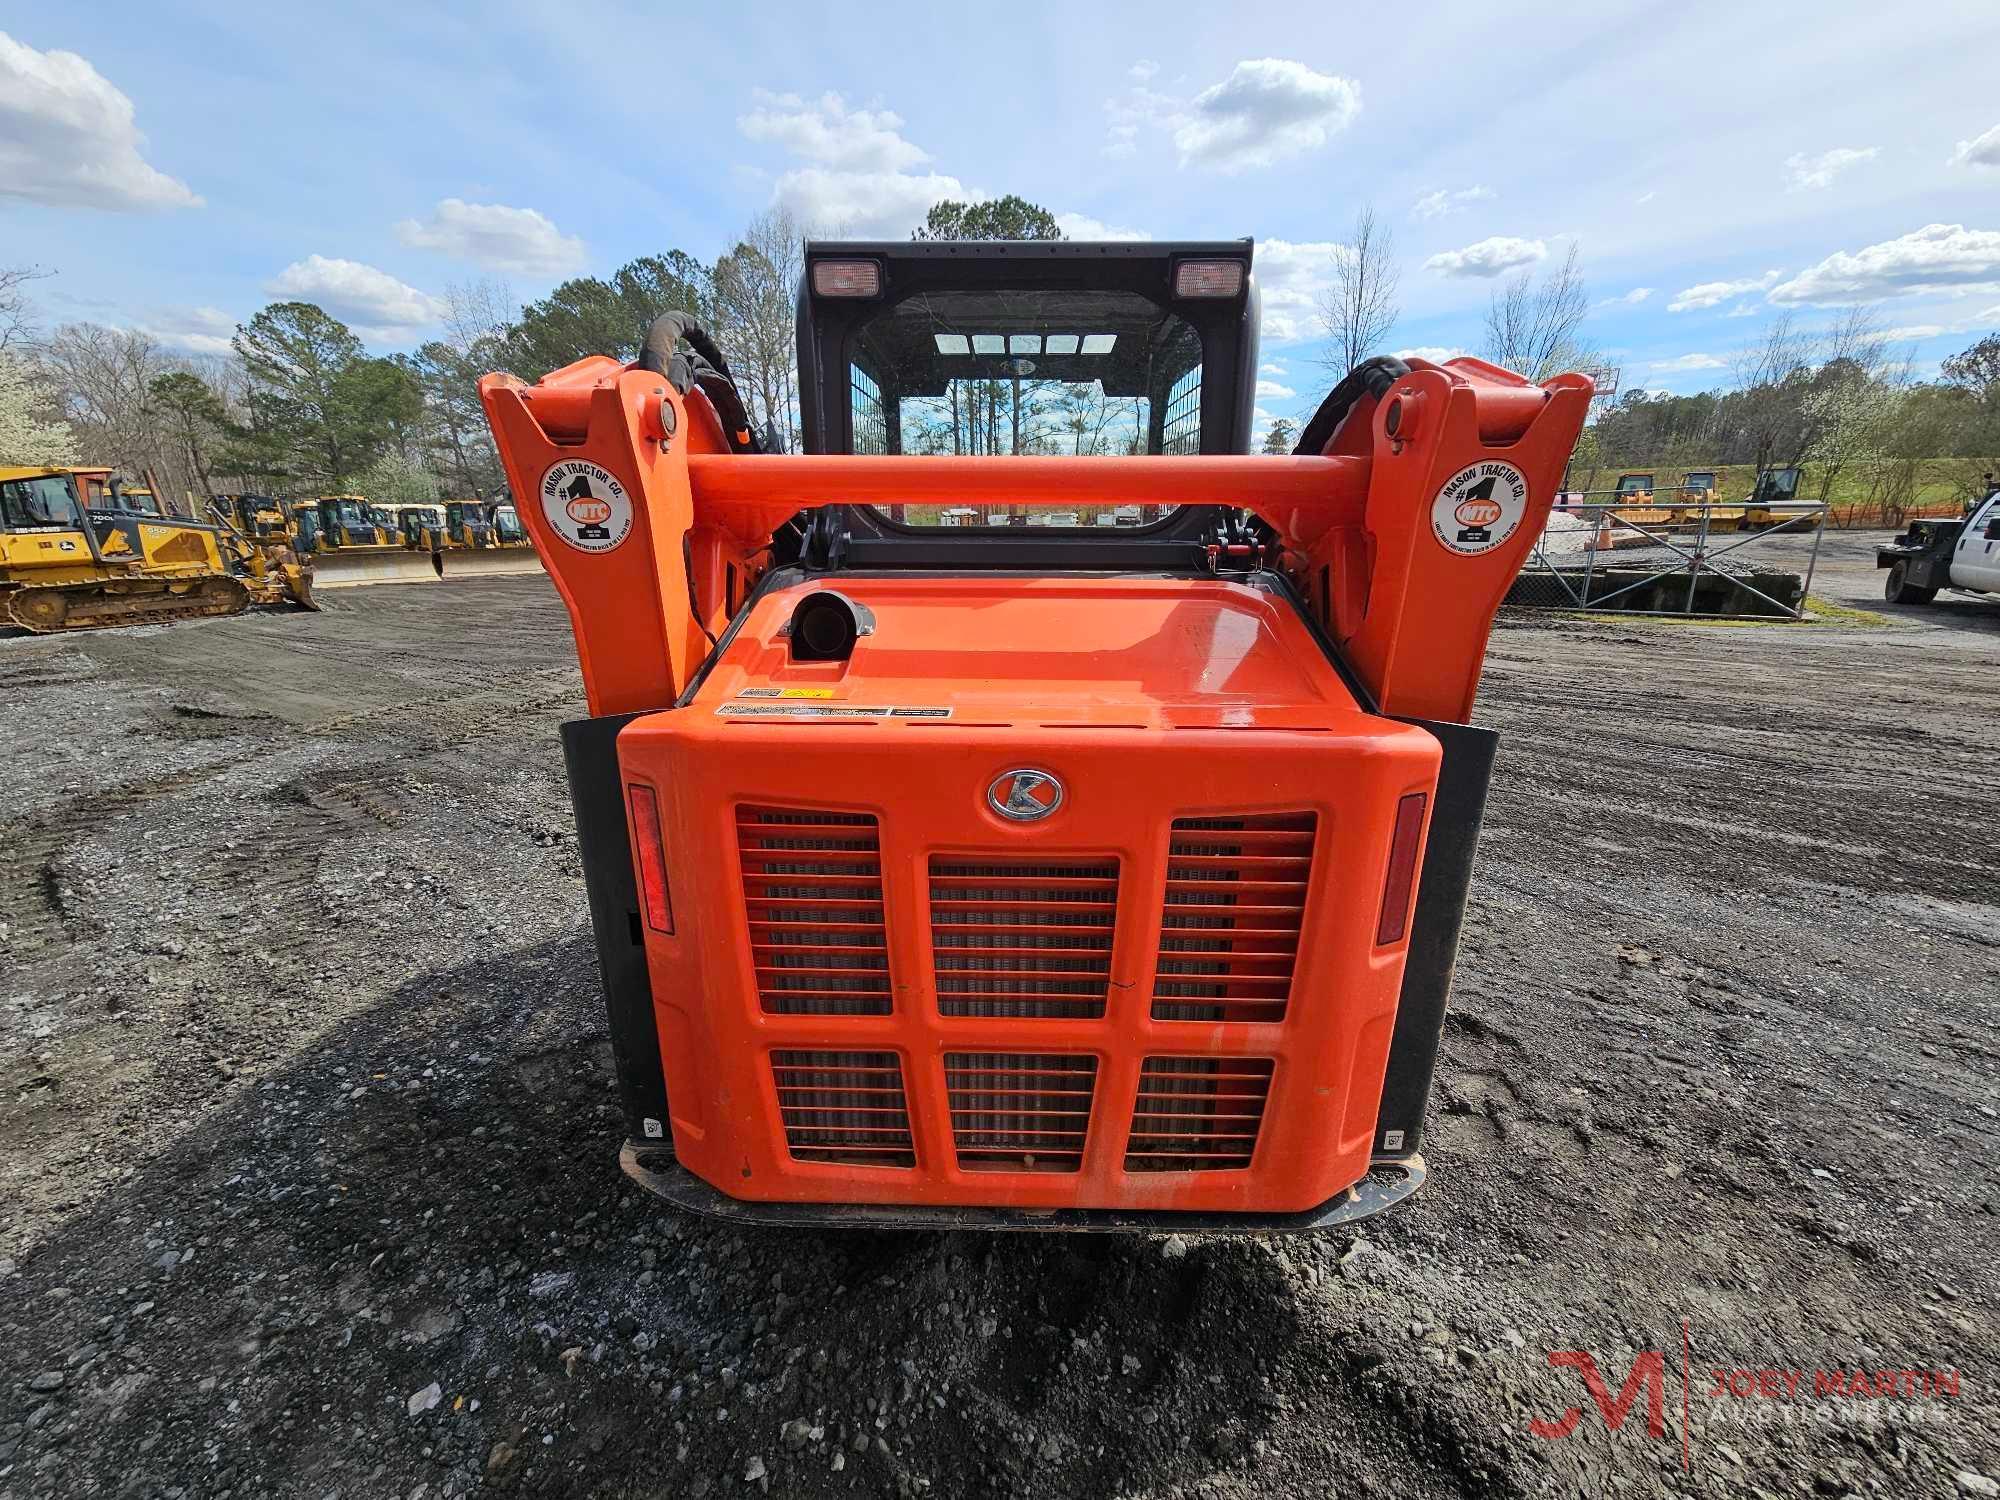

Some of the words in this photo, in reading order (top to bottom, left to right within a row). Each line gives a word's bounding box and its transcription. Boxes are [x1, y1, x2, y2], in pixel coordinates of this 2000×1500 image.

[545, 467, 566, 496] MASON
[565, 463, 609, 484] TRACTOR
[608, 481, 624, 499] CO.
[1443, 468, 1477, 497] MASON
[1480, 464, 1520, 486] TRACTOR
[1512, 484, 1525, 502] CO.
